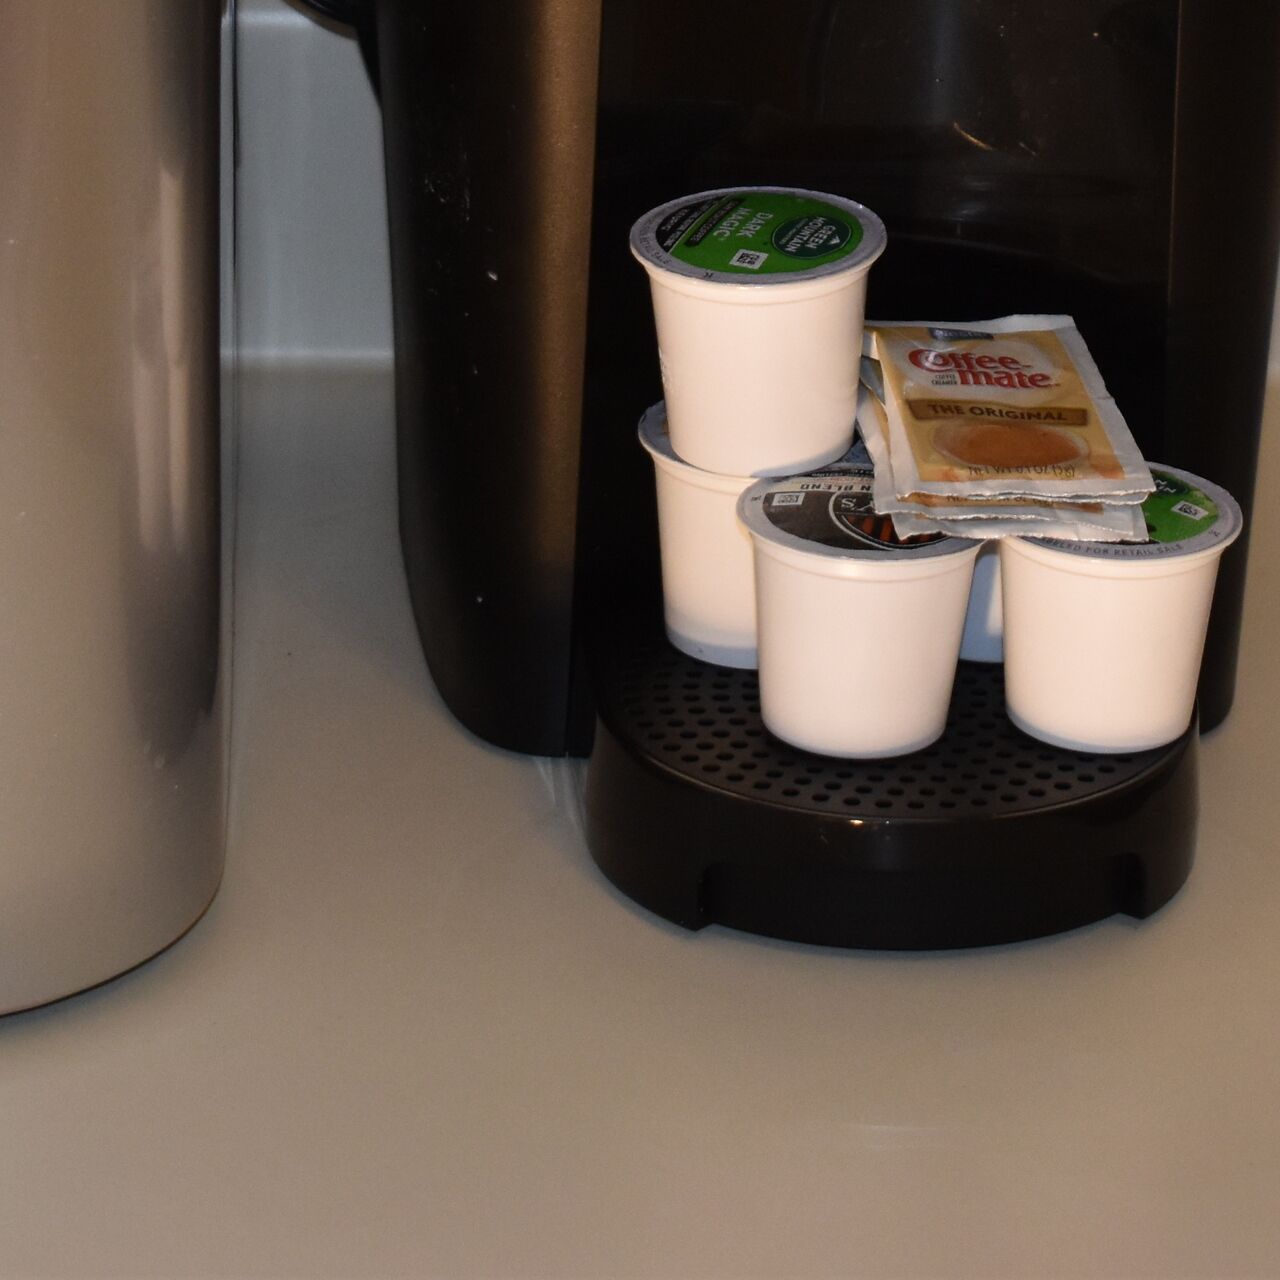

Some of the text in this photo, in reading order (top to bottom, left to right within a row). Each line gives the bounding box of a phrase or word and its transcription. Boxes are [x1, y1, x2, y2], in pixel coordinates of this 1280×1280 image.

[713, 207, 751, 237] MAGIC
[736, 212, 773, 238] DARK
[785, 216, 827, 253] MOUNTAIN
[805, 225, 836, 249] GREEN
[958, 370, 1054, 388] mate
[928, 403, 1068, 421] THE ORIGINAL
[1085, 545, 1109, 554] FOR
[1113, 547, 1154, 556] RETAIL
[1157, 543, 1184, 554] SALE
